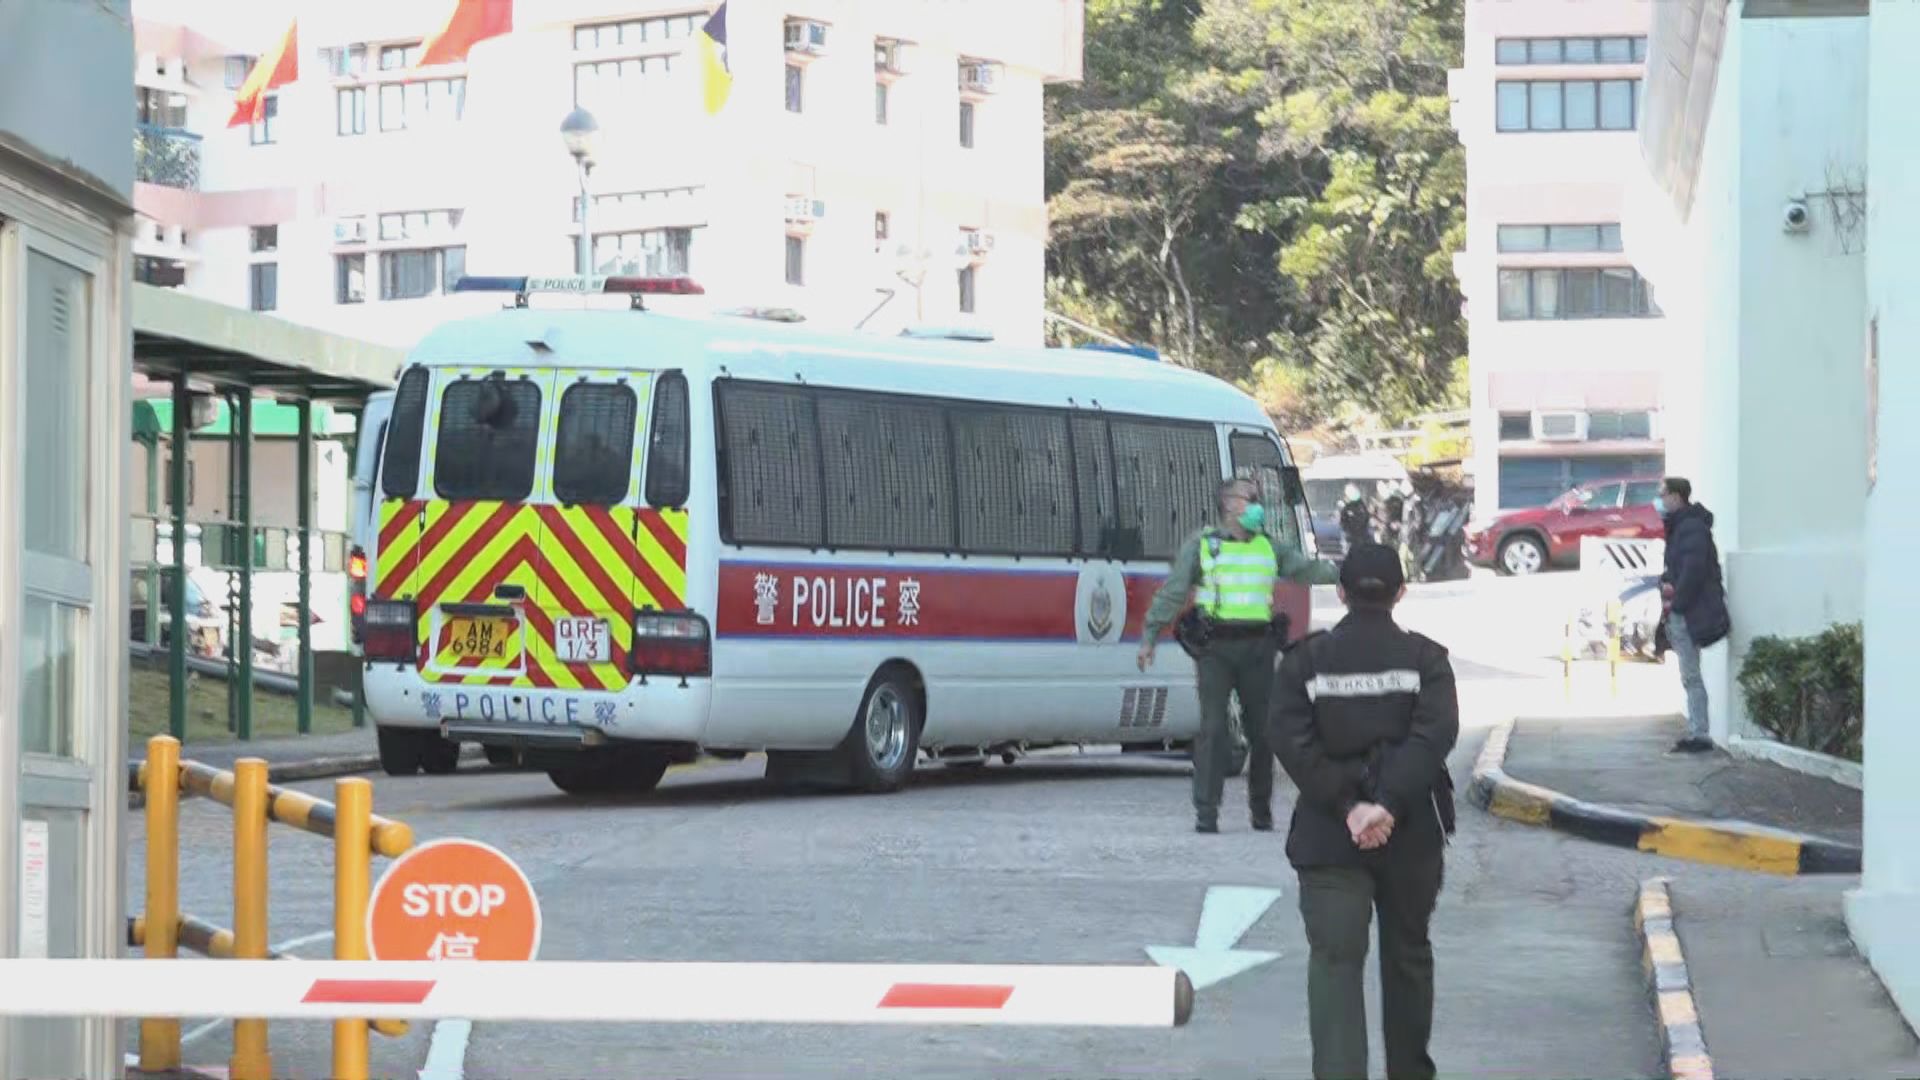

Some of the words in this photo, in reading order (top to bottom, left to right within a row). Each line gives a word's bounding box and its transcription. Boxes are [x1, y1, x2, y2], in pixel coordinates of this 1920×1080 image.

[543, 279, 585, 290] POLICE
[754, 571, 779, 625] 警
[792, 577, 887, 627] POLICE
[898, 577, 921, 626] 察
[467, 622, 493, 640] AM
[560, 620, 603, 639] QRF
[452, 638, 504, 657] 6984
[567, 639, 598, 659] 1/3
[455, 693, 580, 723] POLICE
[402, 882, 506, 917] STOP
